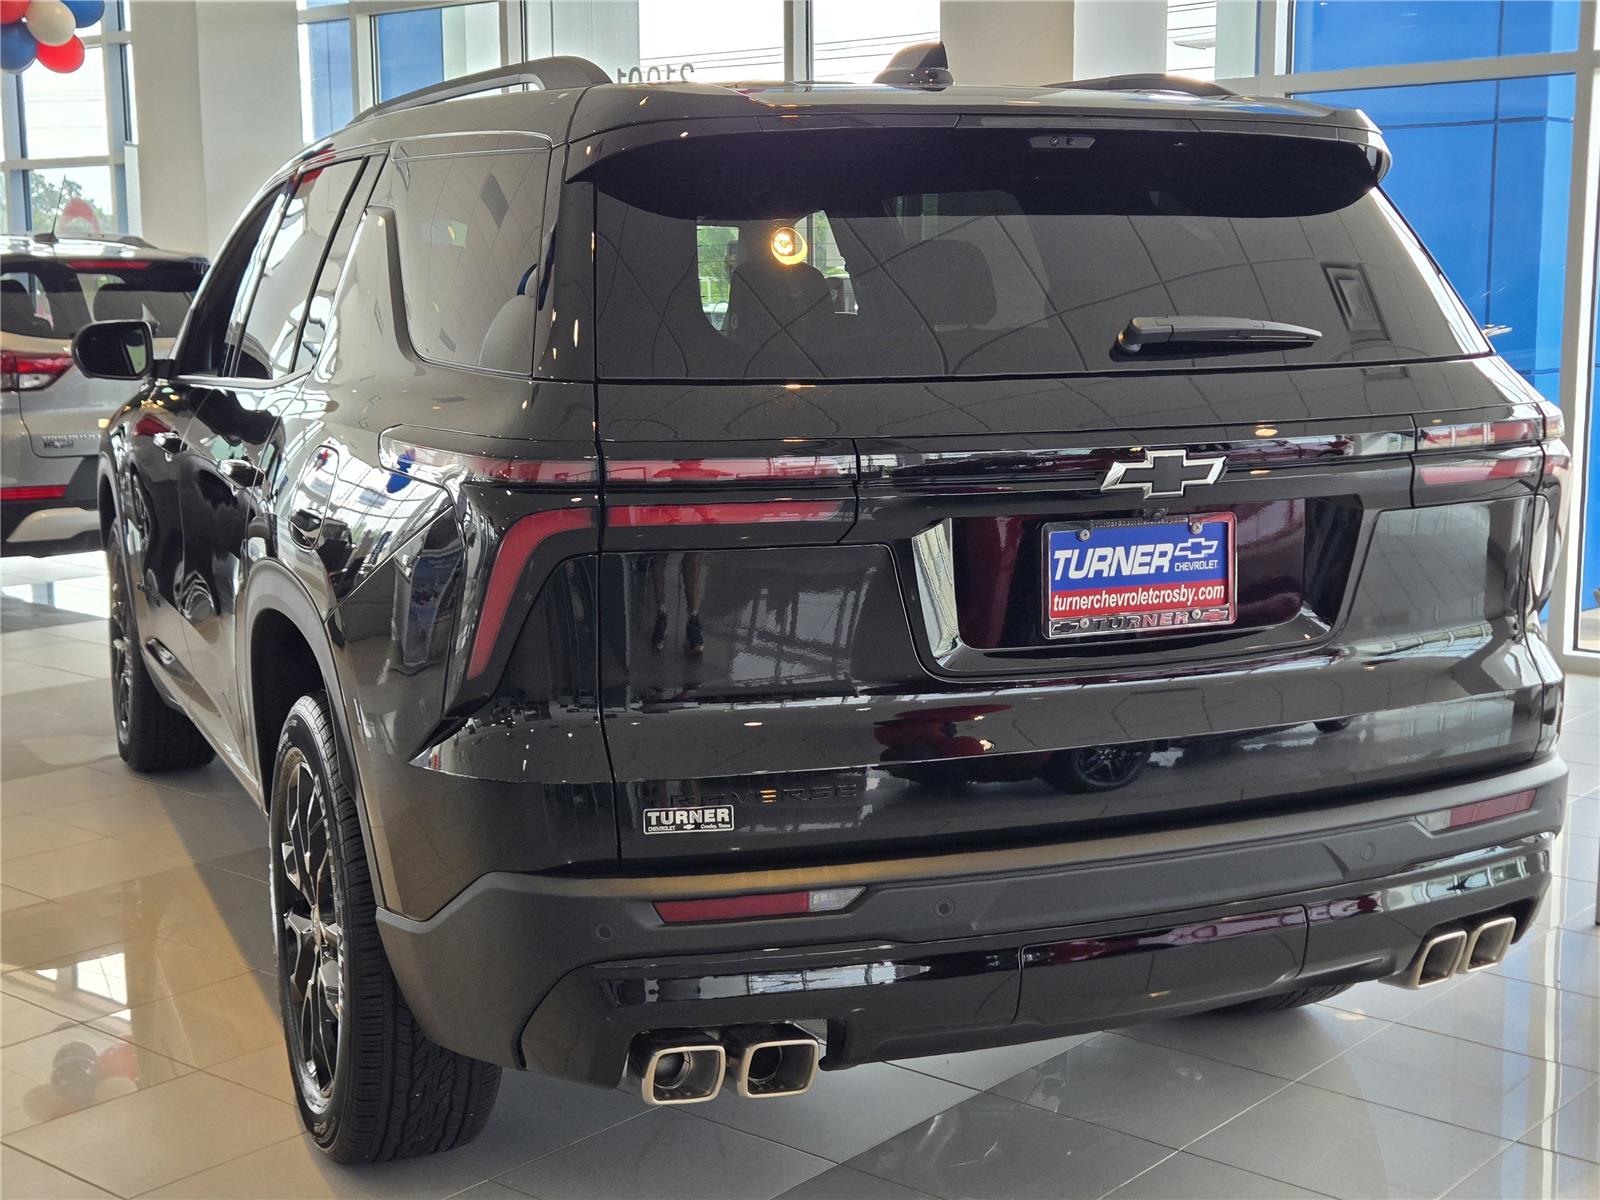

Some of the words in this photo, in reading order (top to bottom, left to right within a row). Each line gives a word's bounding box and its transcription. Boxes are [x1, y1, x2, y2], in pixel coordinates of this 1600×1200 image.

[1053, 543, 1174, 581] TURNER
[1174, 559, 1219, 572] CHEVROLET
[1053, 584, 1225, 612] turnerchevroletcrosby.com
[1091, 611, 1189, 631] TURNER
[647, 808, 730, 825] TURNER
